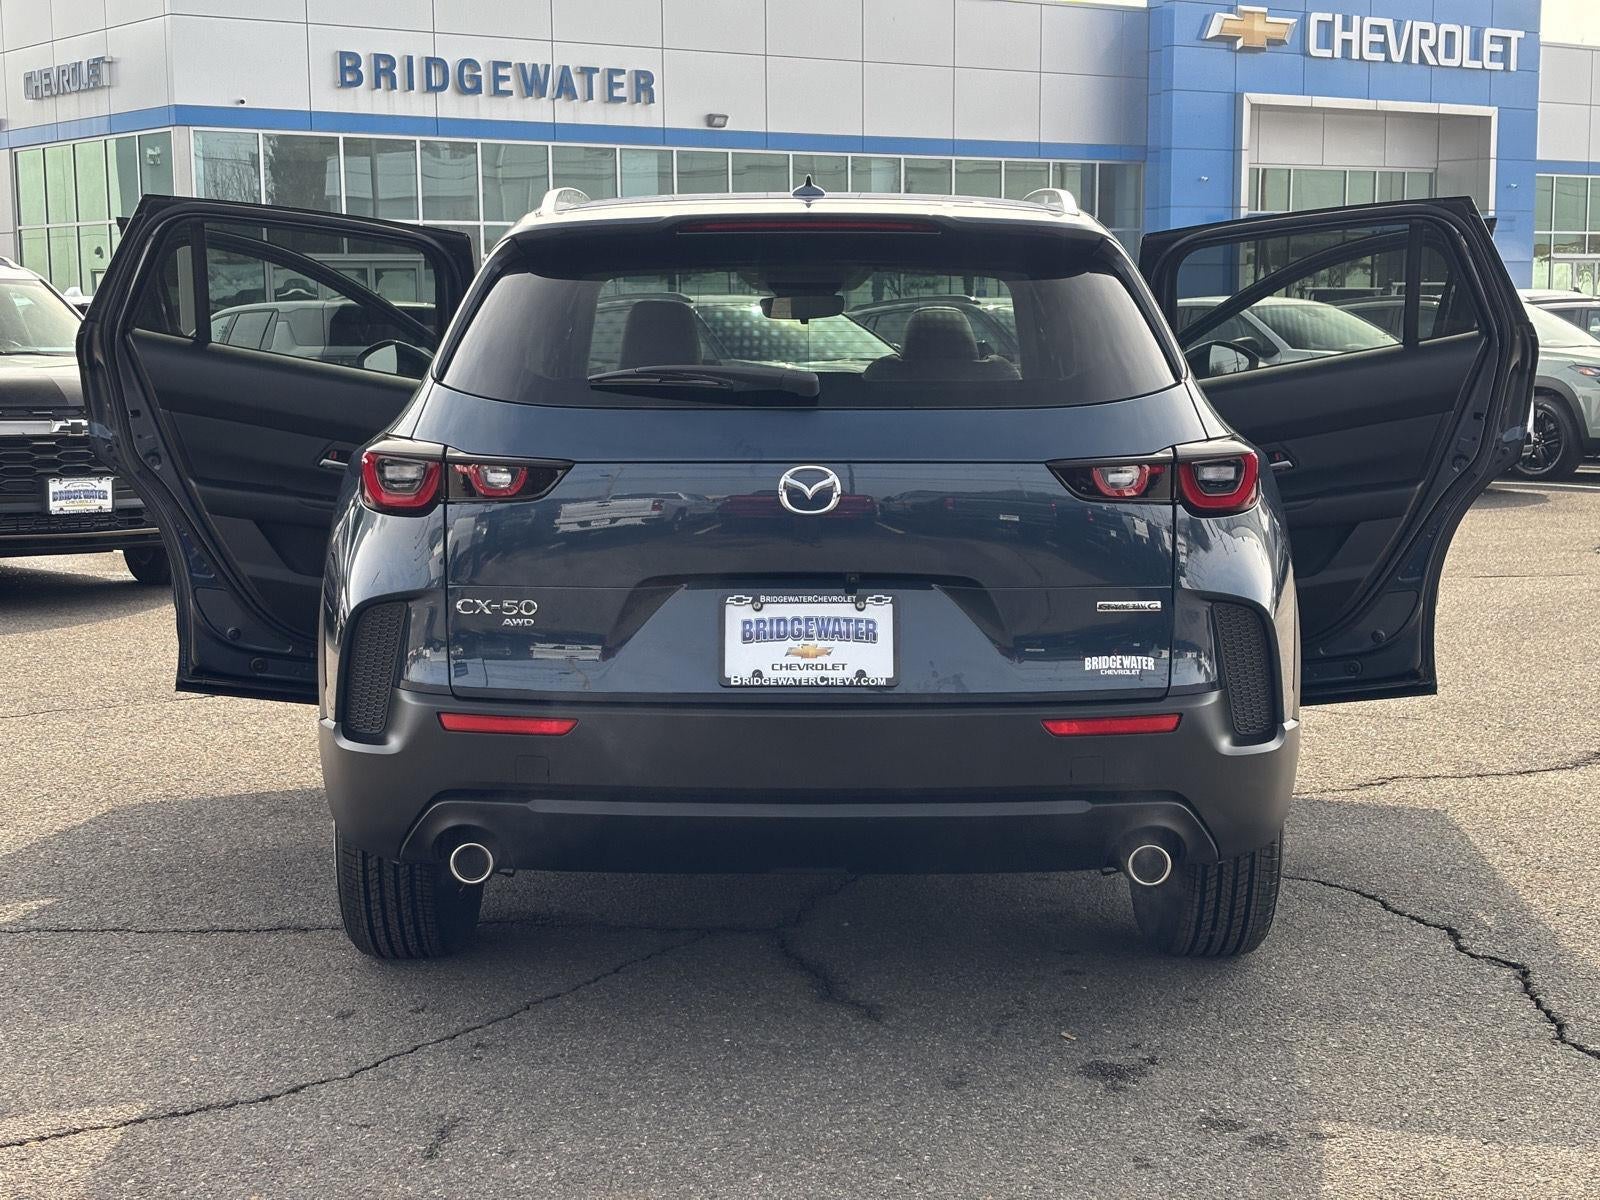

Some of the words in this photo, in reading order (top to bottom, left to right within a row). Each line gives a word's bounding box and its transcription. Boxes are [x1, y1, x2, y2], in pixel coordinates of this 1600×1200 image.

[1309, 12, 1526, 72] CHEVROLET
[24, 56, 112, 100] CHEVROLET
[336, 50, 656, 105] BRIDGEWATER
[52, 489, 108, 502] BRIDGEWATER
[456, 598, 538, 616] CX-50
[502, 618, 535, 627] AWD
[741, 616, 879, 644] BRIDGEWATER
[771, 663, 848, 671] CHEVROLET
[1085, 656, 1155, 671] BRIDGEWATER
[730, 675, 887, 686] BRIDGEWATERCHEVY.COM
